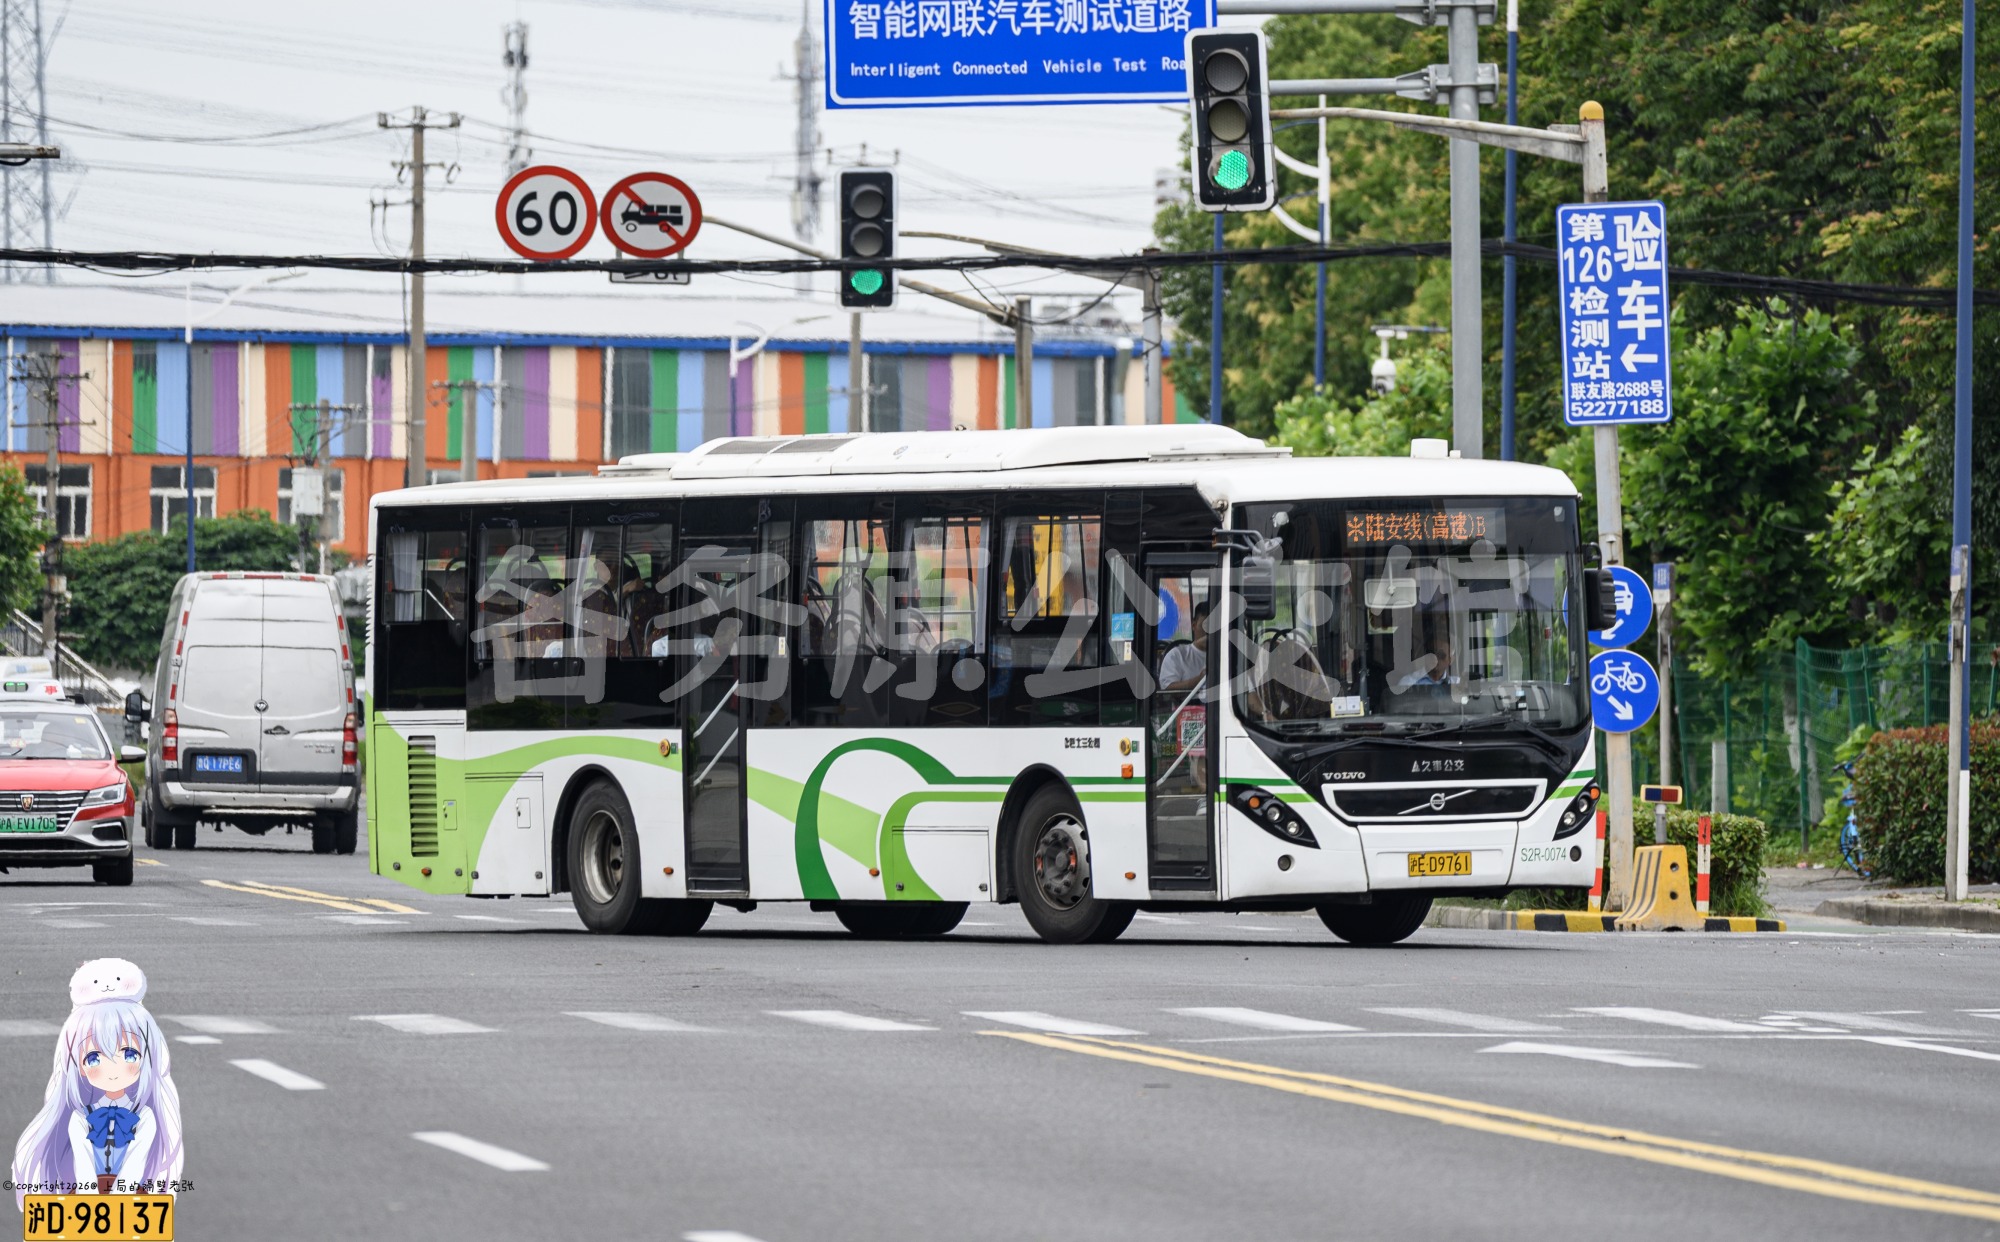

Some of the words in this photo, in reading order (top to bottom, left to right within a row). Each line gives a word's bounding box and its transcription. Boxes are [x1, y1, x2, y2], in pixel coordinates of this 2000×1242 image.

[849, 0, 1192, 39] 智能网联汽车测试道路
[952, 60, 1028, 75] Connected
[1043, 58, 1102, 73] Vehicle
[1113, 57, 1147, 72] Test
[1161, 56, 1187, 71] Roa
[516, 191, 577, 236] 60
[1614, 211, 1662, 340] 验车
[1570, 380, 1665, 401] 联友路2688号
[1571, 399, 1664, 417] 52277188
[1322, 772, 1366, 780] VOLVO
[1520, 847, 1567, 862] S2R-0074
